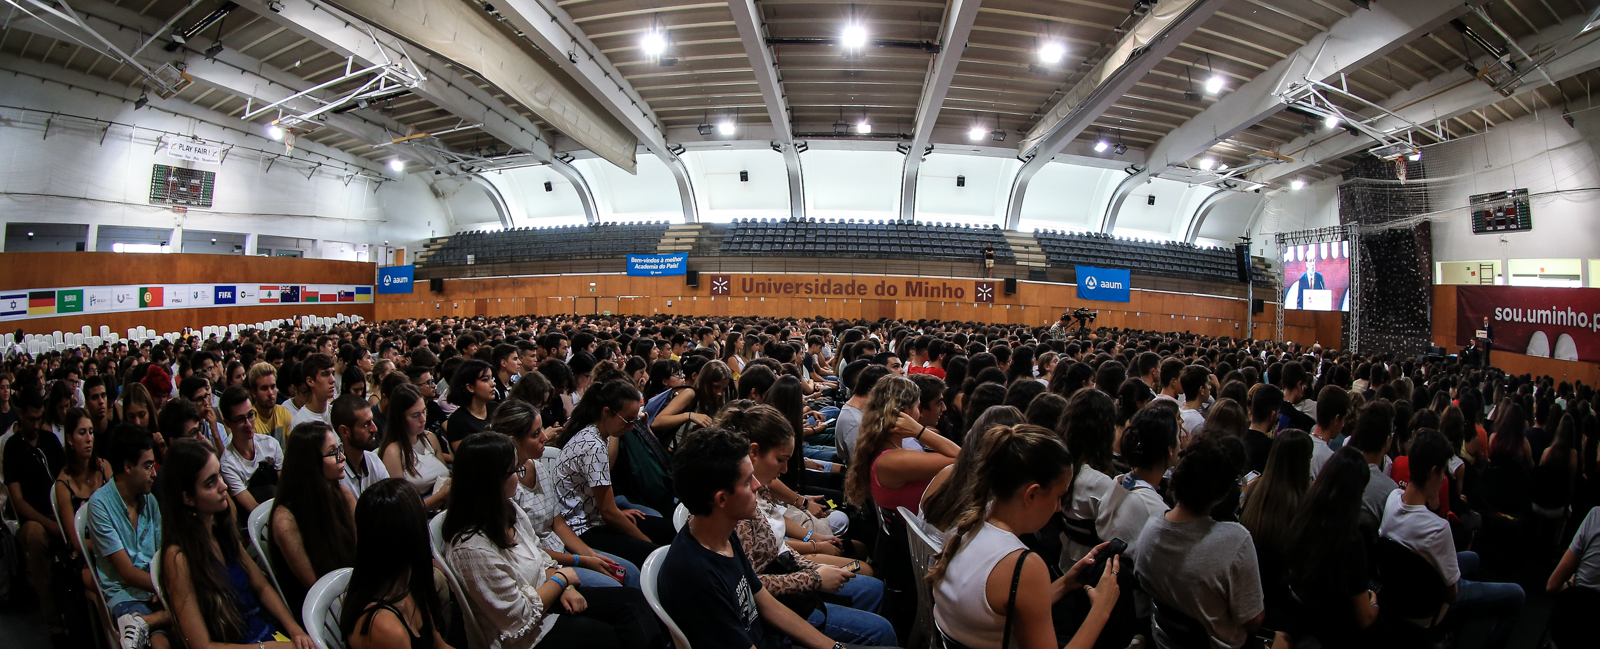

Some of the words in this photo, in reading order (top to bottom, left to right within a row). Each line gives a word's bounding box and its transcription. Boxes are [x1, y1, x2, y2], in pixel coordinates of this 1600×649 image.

[178, 143, 193, 153] PLAY
[392, 276, 409, 284] aaum
[1100, 280, 1122, 290] aaum
[741, 277, 868, 297] Universidade
[874, 280, 898, 297] do
[905, 281, 965, 299] Minho
[218, 291, 232, 299] FIFA
